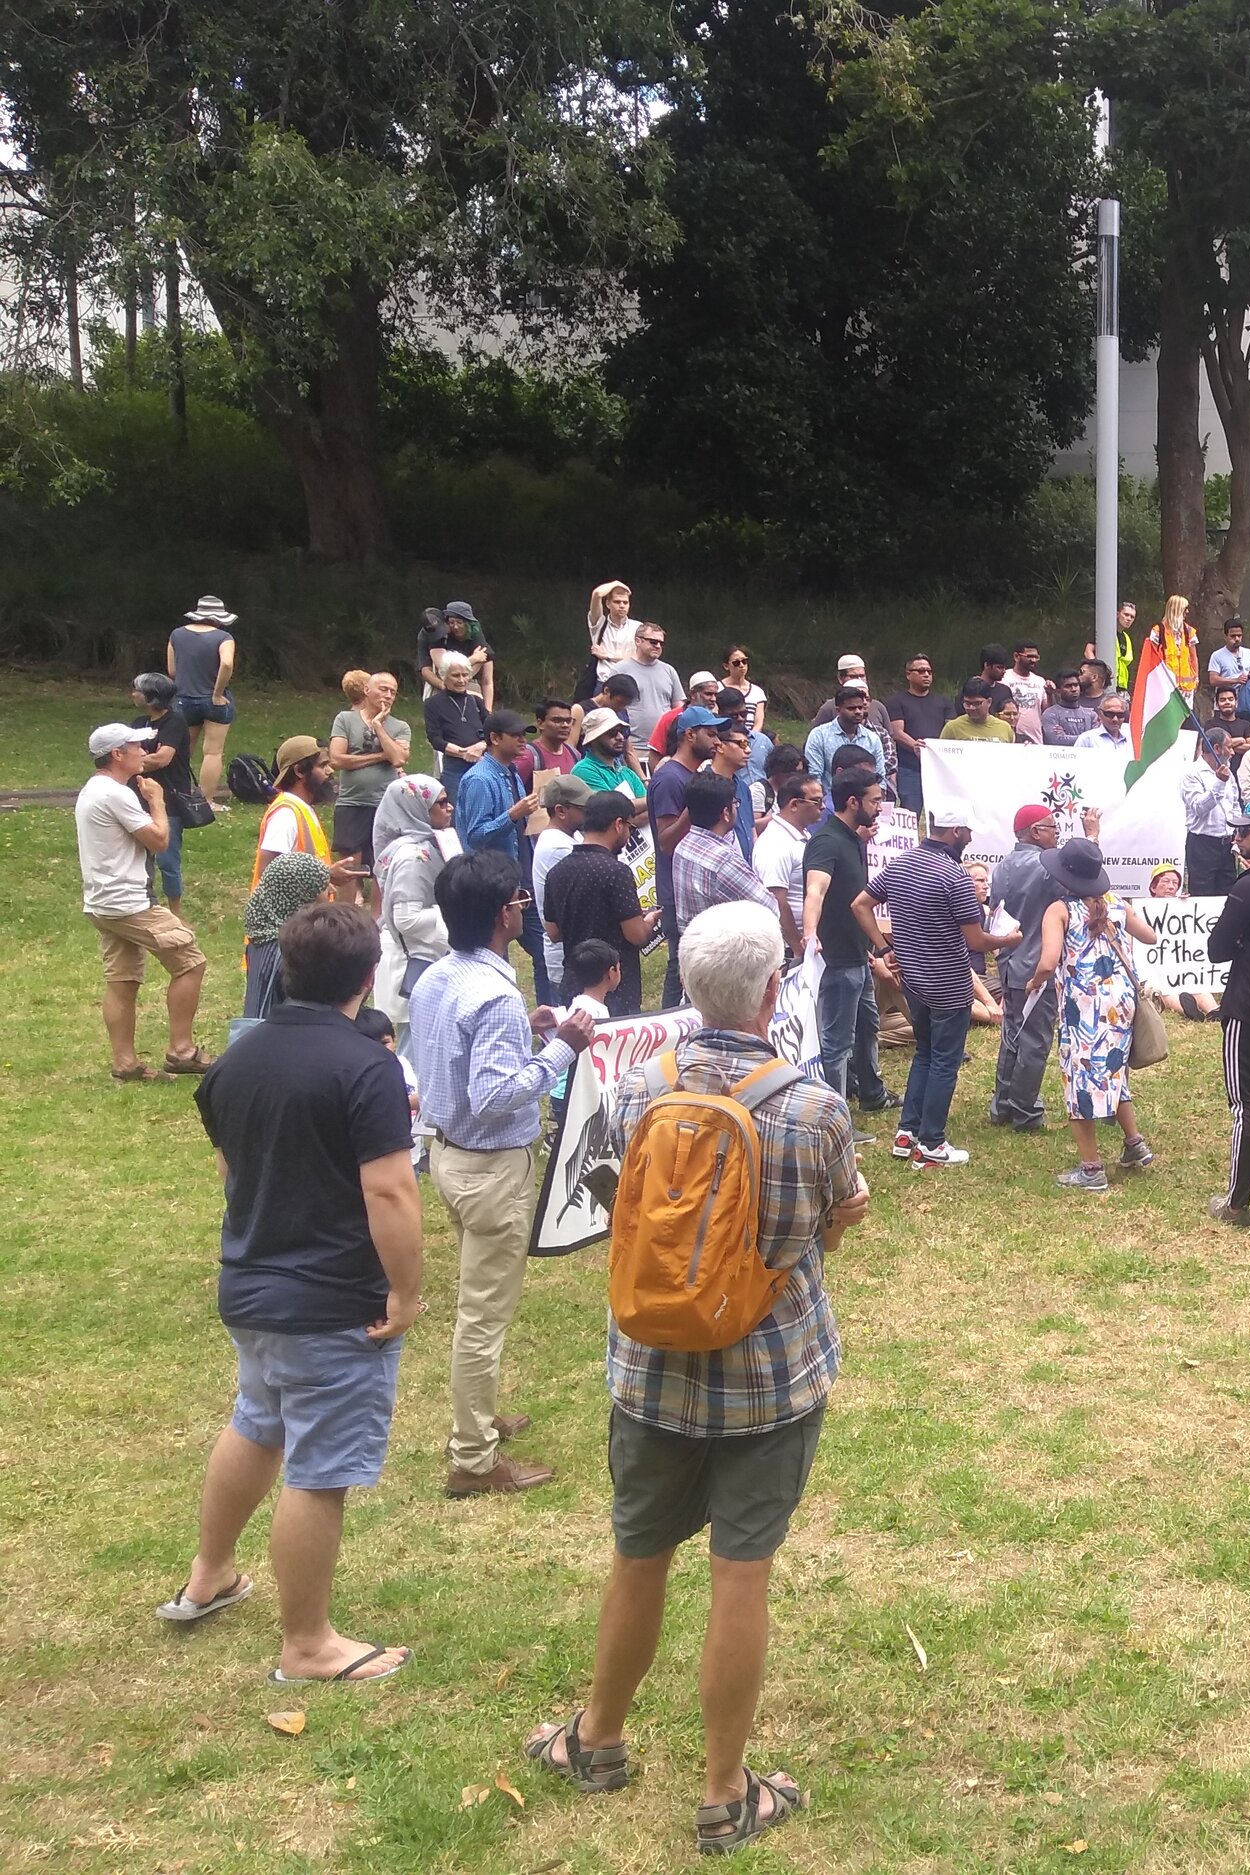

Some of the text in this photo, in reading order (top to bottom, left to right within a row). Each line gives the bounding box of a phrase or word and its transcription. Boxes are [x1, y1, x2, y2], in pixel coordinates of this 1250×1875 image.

[1049, 752, 1077, 760] EQUALITY
[889, 812, 918, 831] STICE
[626, 841, 650, 863] RACISM
[867, 853, 879, 868] IS
[963, 853, 1182, 866] ASSOCIA NEW ZEALAND INC.
[1142, 903, 1221, 935] Worke
[1146, 938, 1206, 965] of the
[1167, 964, 1231, 987] unite
[589, 1022, 668, 1086] STOP
